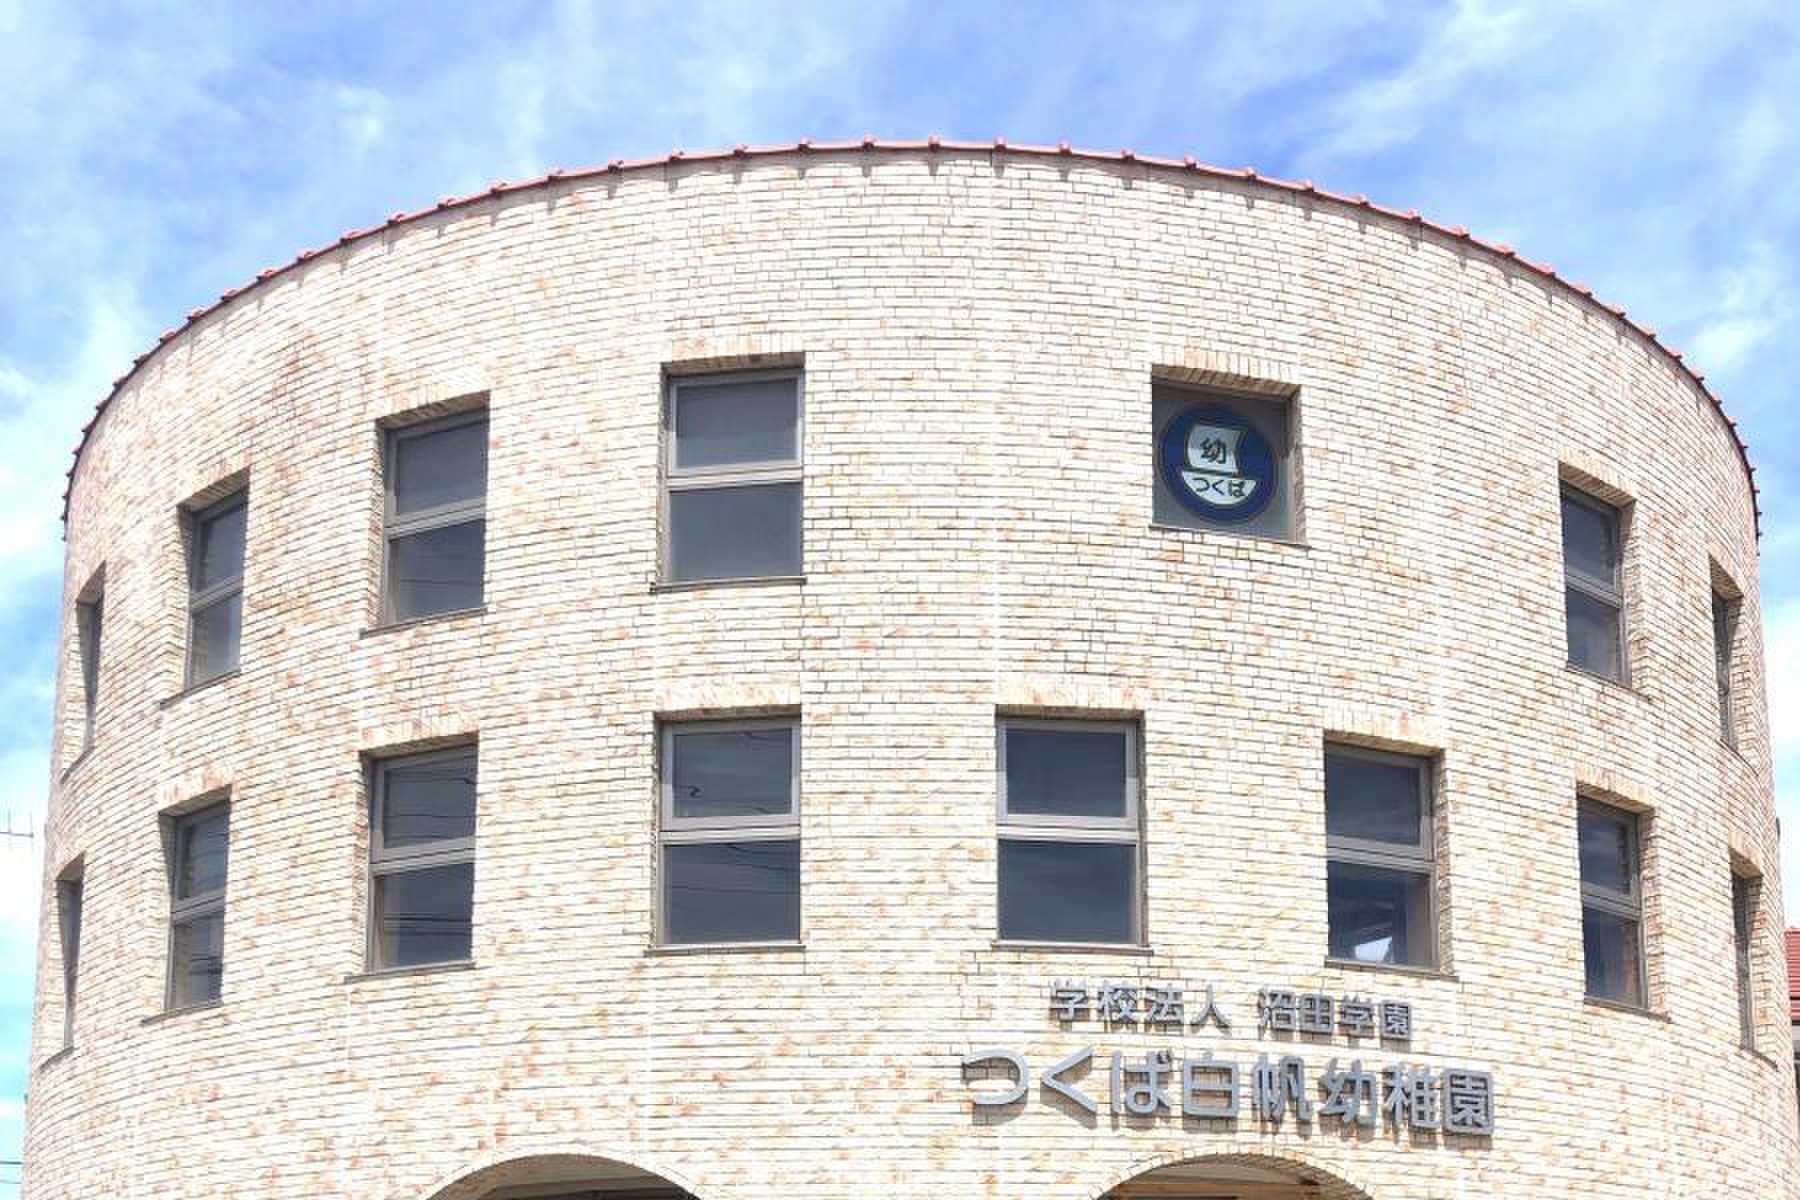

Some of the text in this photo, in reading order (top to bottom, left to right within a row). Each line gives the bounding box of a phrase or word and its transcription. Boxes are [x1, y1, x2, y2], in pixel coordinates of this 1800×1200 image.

[1050, 979, 1413, 1040] 学校法人 沼田学園
[961, 1046, 1494, 1136] つくば白帆幼稚園
